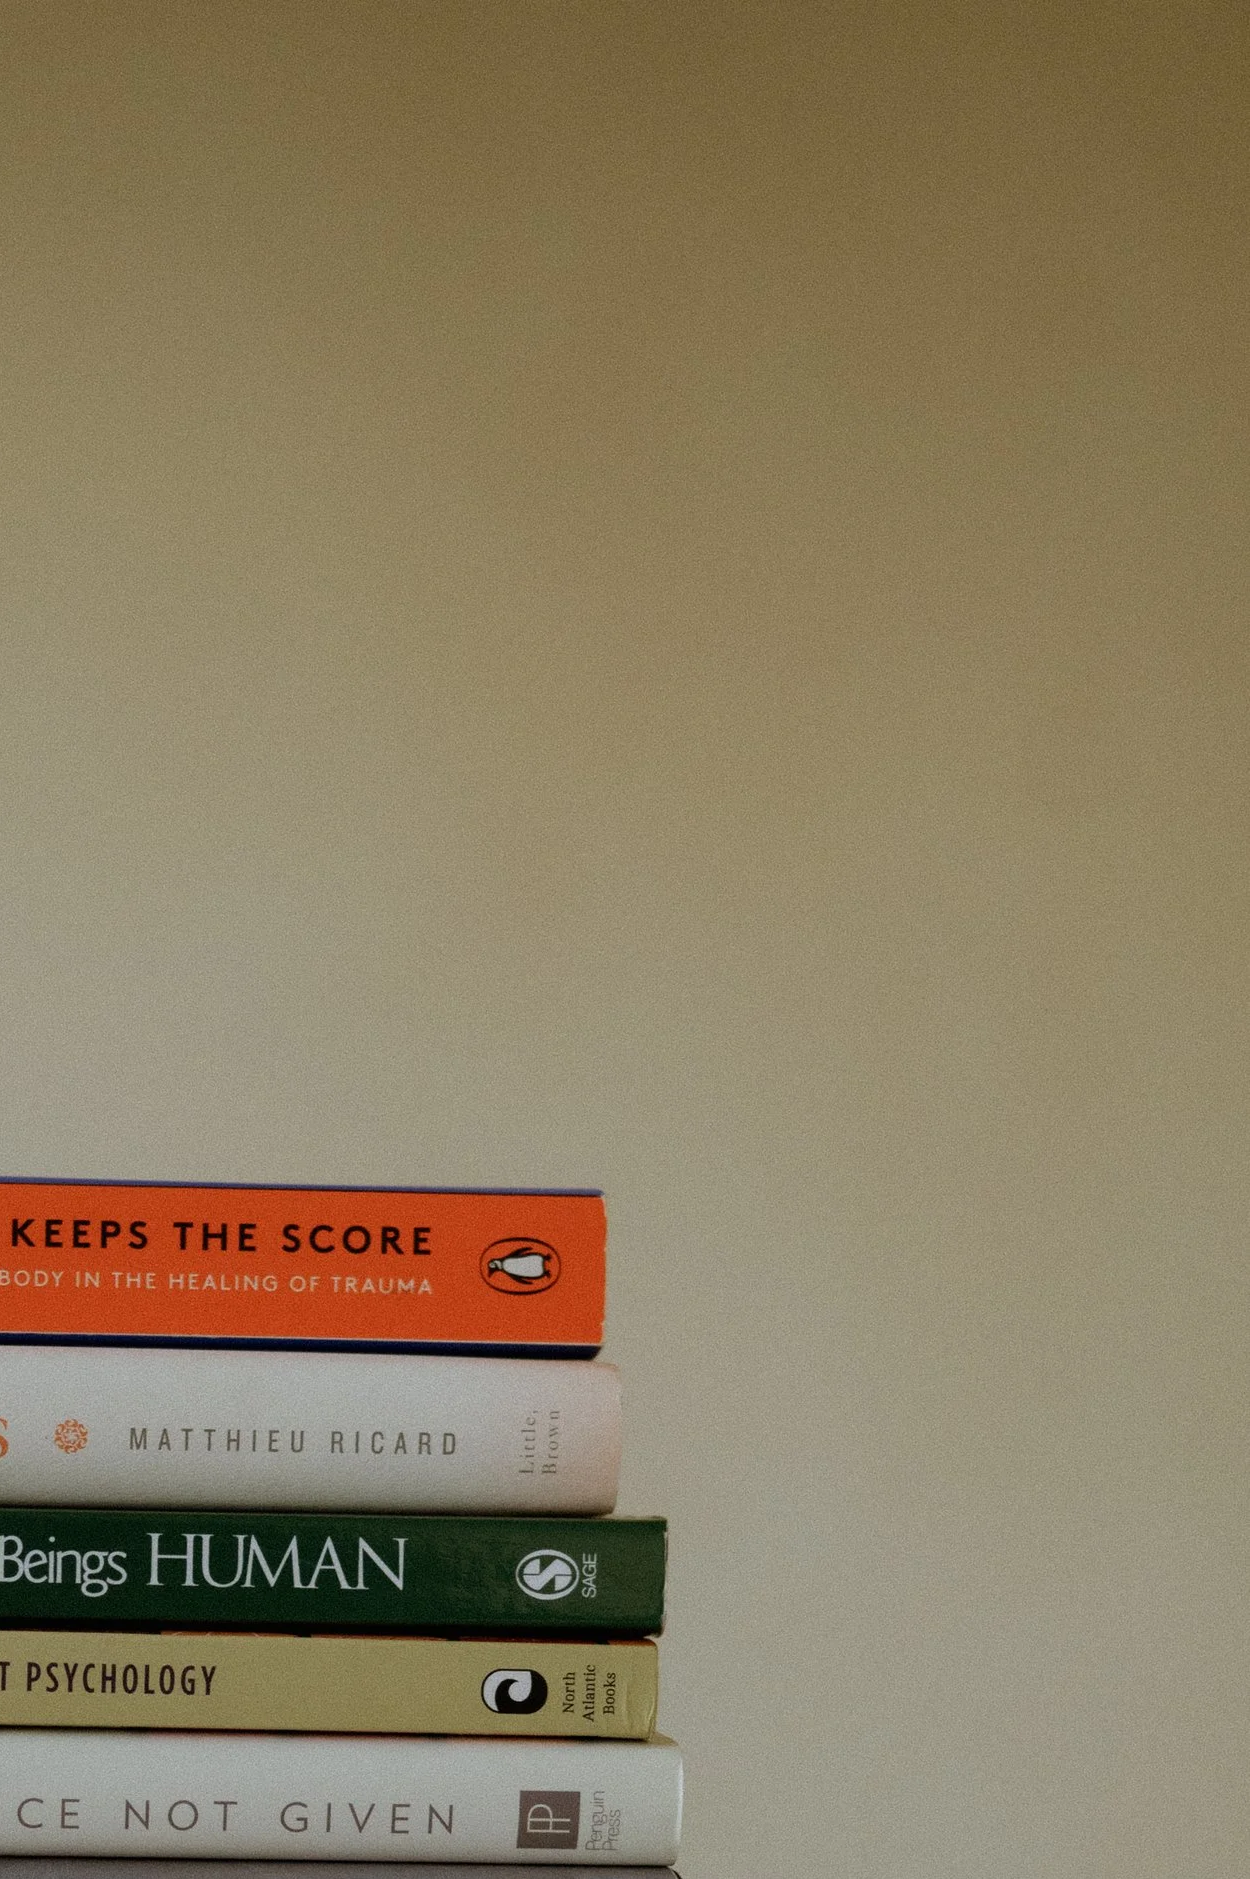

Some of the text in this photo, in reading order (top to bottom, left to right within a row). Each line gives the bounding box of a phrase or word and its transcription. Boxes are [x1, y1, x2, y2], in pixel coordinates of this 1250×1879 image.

[12, 1219, 148, 1248] KEEPS
[173, 1222, 256, 1251] THE
[282, 1224, 431, 1255] SCORE
[76, 1271, 99, 1288] IN
[112, 1272, 155, 1289] THE
[170, 1273, 277, 1292] HEALING
[290, 1275, 320, 1293] OF
[330, 1276, 432, 1295] TRAUMA
[129, 1427, 458, 1455] MATTHIEU RICARD
[519, 1409, 537, 1474] Little,
[542, 1409, 559, 1475] Brown
[146, 1532, 406, 1591] HUMAN
[582, 1552, 598, 1598] SAGE
[26, 1661, 218, 1695] PSYCHOLOGY
[562, 1671, 576, 1714] North
[582, 1664, 596, 1722] Atlantic
[603, 1672, 616, 1715] Books
[125, 1801, 238, 1830] NOT
[281, 1802, 454, 1834] GIVEN
[586, 1791, 606, 1851] Penguin
[604, 1809, 621, 1851] Press
